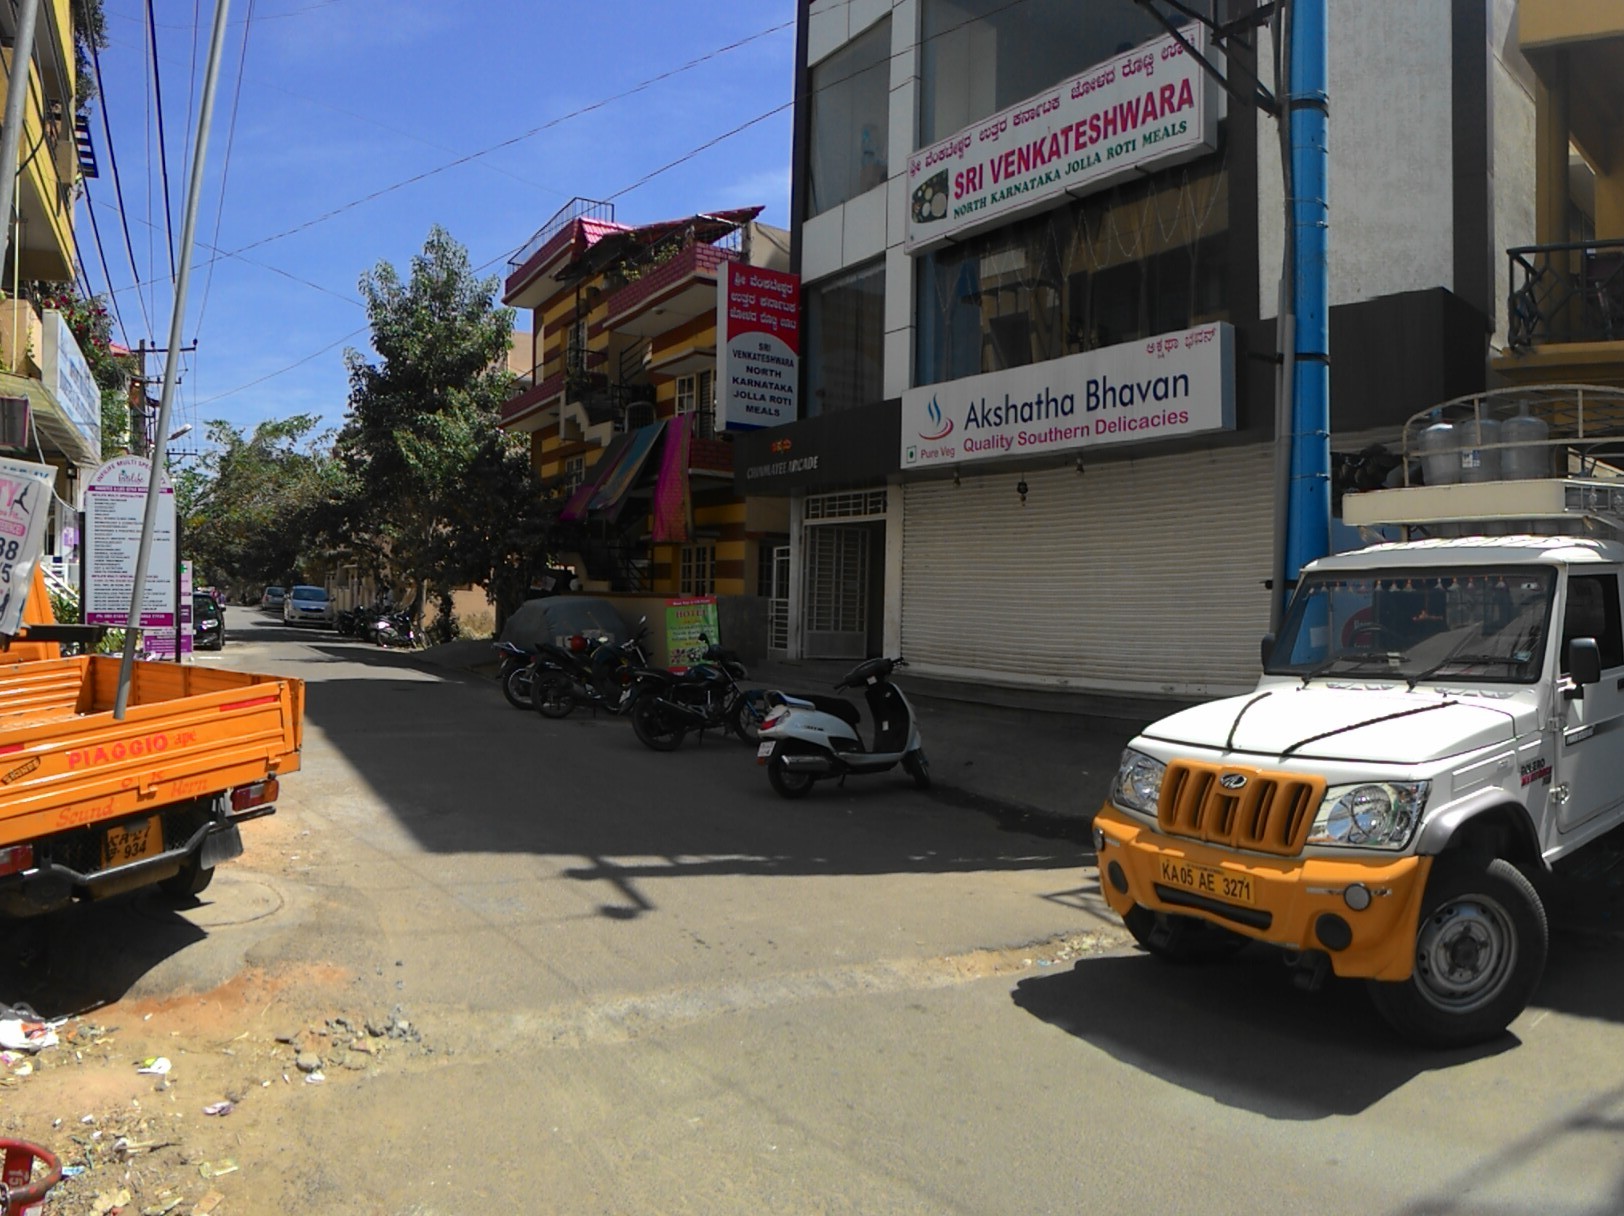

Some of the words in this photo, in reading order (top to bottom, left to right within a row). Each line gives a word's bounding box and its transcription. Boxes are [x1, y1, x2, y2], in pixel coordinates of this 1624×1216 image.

[954, 162, 984, 200] SRI
[990, 78, 1195, 184] VENKATESHWARA
[953, 197, 987, 219] NORTH
[990, 169, 1062, 204] KARNATAKA
[1065, 152, 1102, 176] JOLLA
[1107, 139, 1137, 160] ROTI
[1142, 120, 1188, 147] MEALS
[733, 349, 794, 368] VENKATESHWARA
[758, 343, 771, 353] SRI
[746, 365, 781, 379] NORTH
[732, 376, 793, 393] KARNATAKA
[734, 390, 766, 402] JOLLA
[769, 395, 792, 406] ROTI
[964, 387, 1074, 431] Akshatha
[1086, 373, 1189, 413] Bhavan
[745, 404, 780, 417] MEALS
[964, 434, 1013, 454] Quality
[1018, 424, 1090, 447] Southern
[1095, 409, 1189, 435] Delicacies
[921, 448, 939, 459] Pure
[941, 446, 955, 459] Veg
[69, 732, 168, 769] PIAGGIO
[56, 796, 116, 828] Sound
[171, 778, 209, 799] Horn
[1199, 872, 1216, 892] AE
[1223, 877, 1251, 900] 3271
